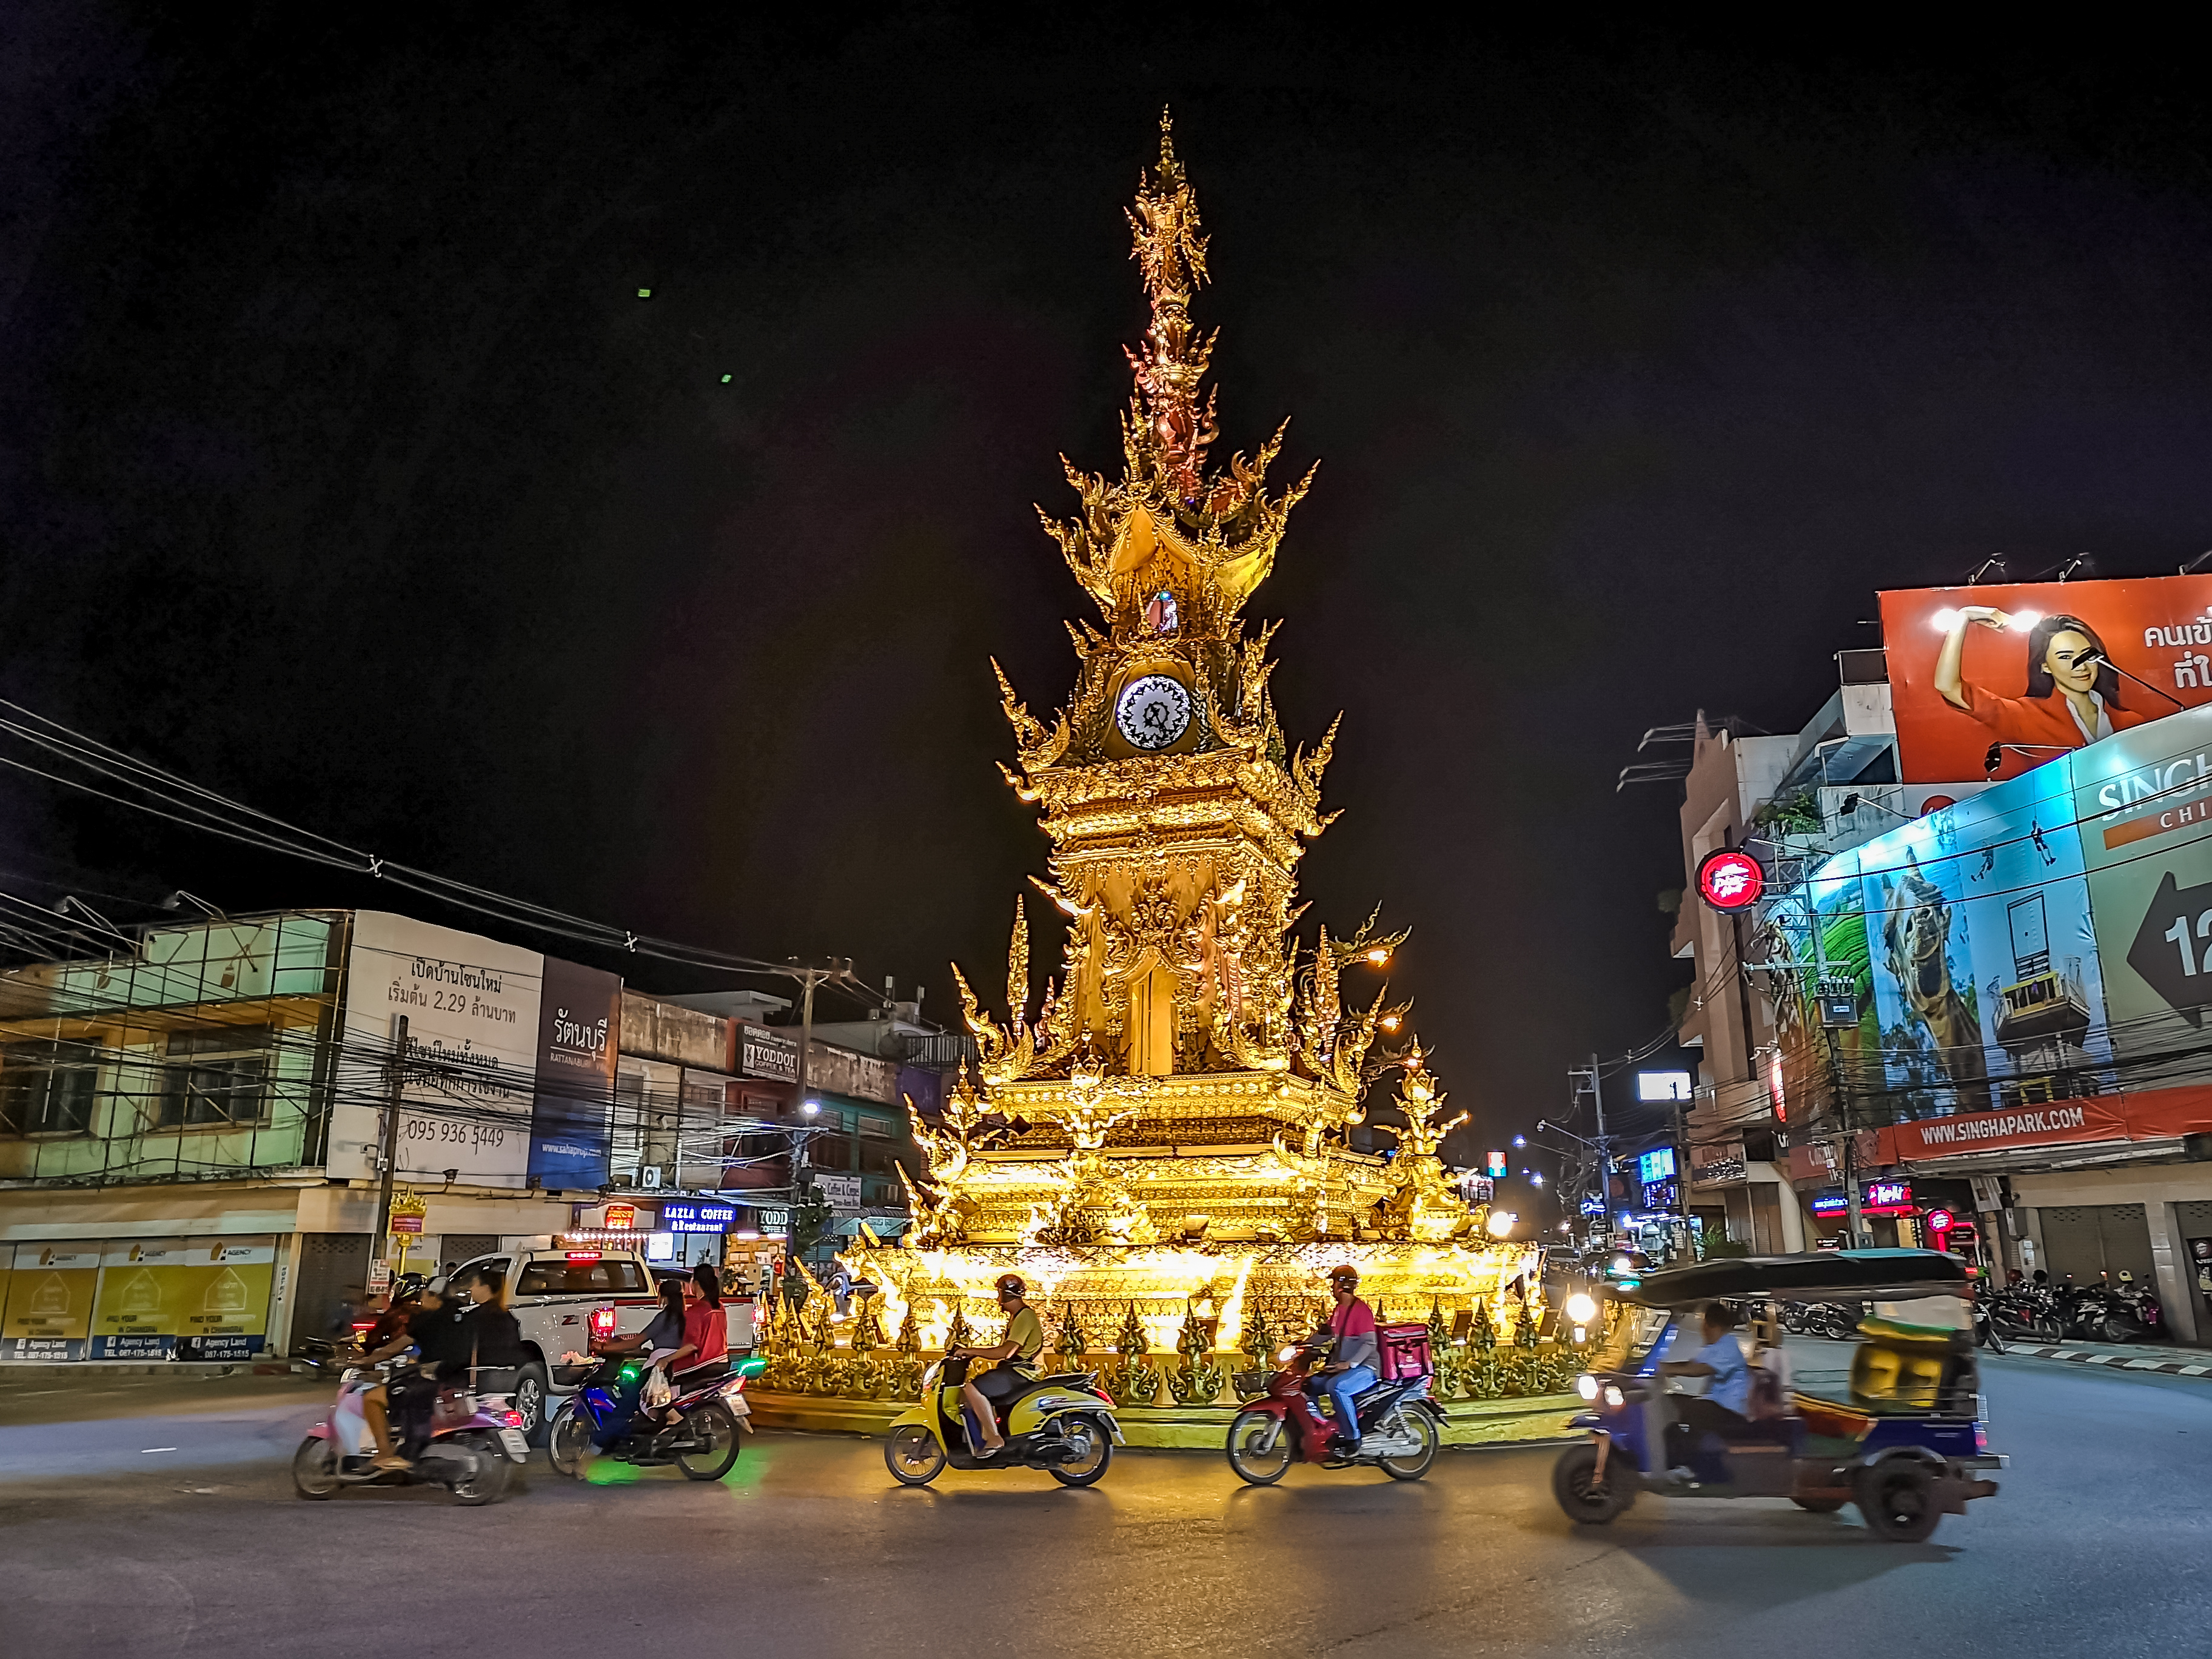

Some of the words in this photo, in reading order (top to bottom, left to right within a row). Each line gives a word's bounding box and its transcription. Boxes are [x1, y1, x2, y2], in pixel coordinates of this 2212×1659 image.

[388, 977, 427, 1007] เริ่มต้น
[434, 991, 466, 1013] 2.29
[472, 996, 515, 1024] ล้านบาท
[554, 1007, 608, 1061] รัตนบุรี
[408, 1121, 435, 1140] 095
[441, 1123, 466, 1144] 936
[471, 1125, 504, 1147] 5449
[1920, 1107, 2085, 1145] WWW.SINGHAPARK.COM
[665, 1207, 695, 1219] LAZLA
[700, 1209, 734, 1221] COFFEE
[205, 1338, 229, 1348] Agency
[230, 1338, 247, 1346] Land
